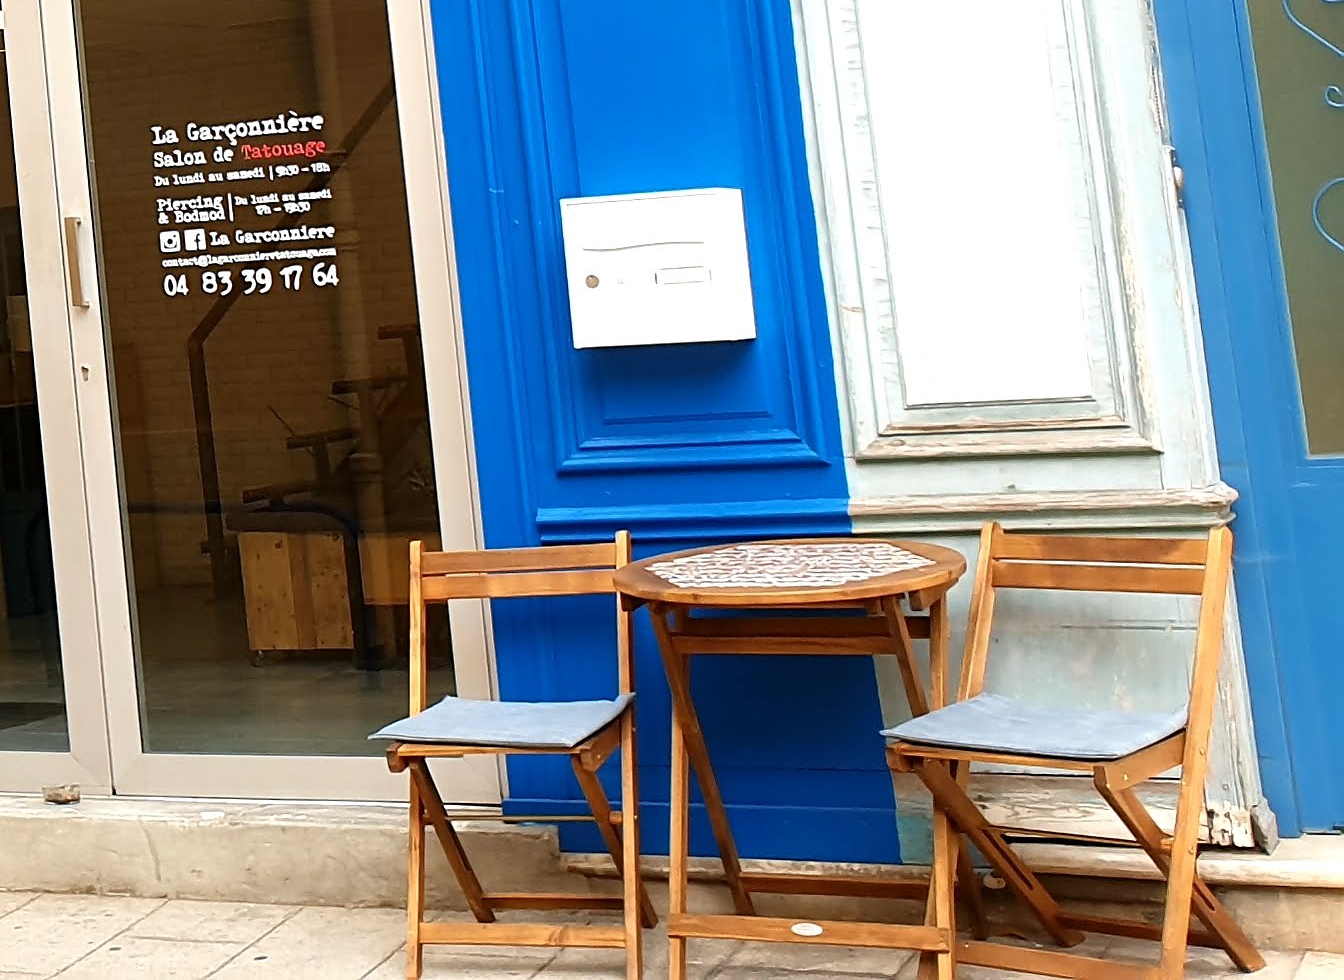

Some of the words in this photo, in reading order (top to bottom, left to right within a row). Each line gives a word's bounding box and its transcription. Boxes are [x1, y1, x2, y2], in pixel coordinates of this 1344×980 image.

[150, 125, 179, 145] La
[187, 110, 324, 146] Garçonnière
[154, 149, 207, 168] Salon
[213, 146, 234, 162] de
[241, 140, 327, 160] Tatouage
[154, 175, 170, 187] Du
[172, 172, 205, 185] lundi
[208, 173, 224, 182] au
[226, 166, 265, 180] samedi
[156, 195, 223, 212] Piercing
[234, 195, 248, 206] Du
[251, 193, 280, 205] lundi
[282, 194, 295, 202] au
[298, 188, 332, 200] samedi
[158, 212, 169, 225] &
[174, 209, 226, 224] Bodmod
[209, 231, 230, 246] La
[164, 274, 189, 296] 04
[201, 270, 233, 296] 83
[241, 268, 273, 294] 39
[279, 265, 303, 291] 17
[313, 262, 339, 287] 64
